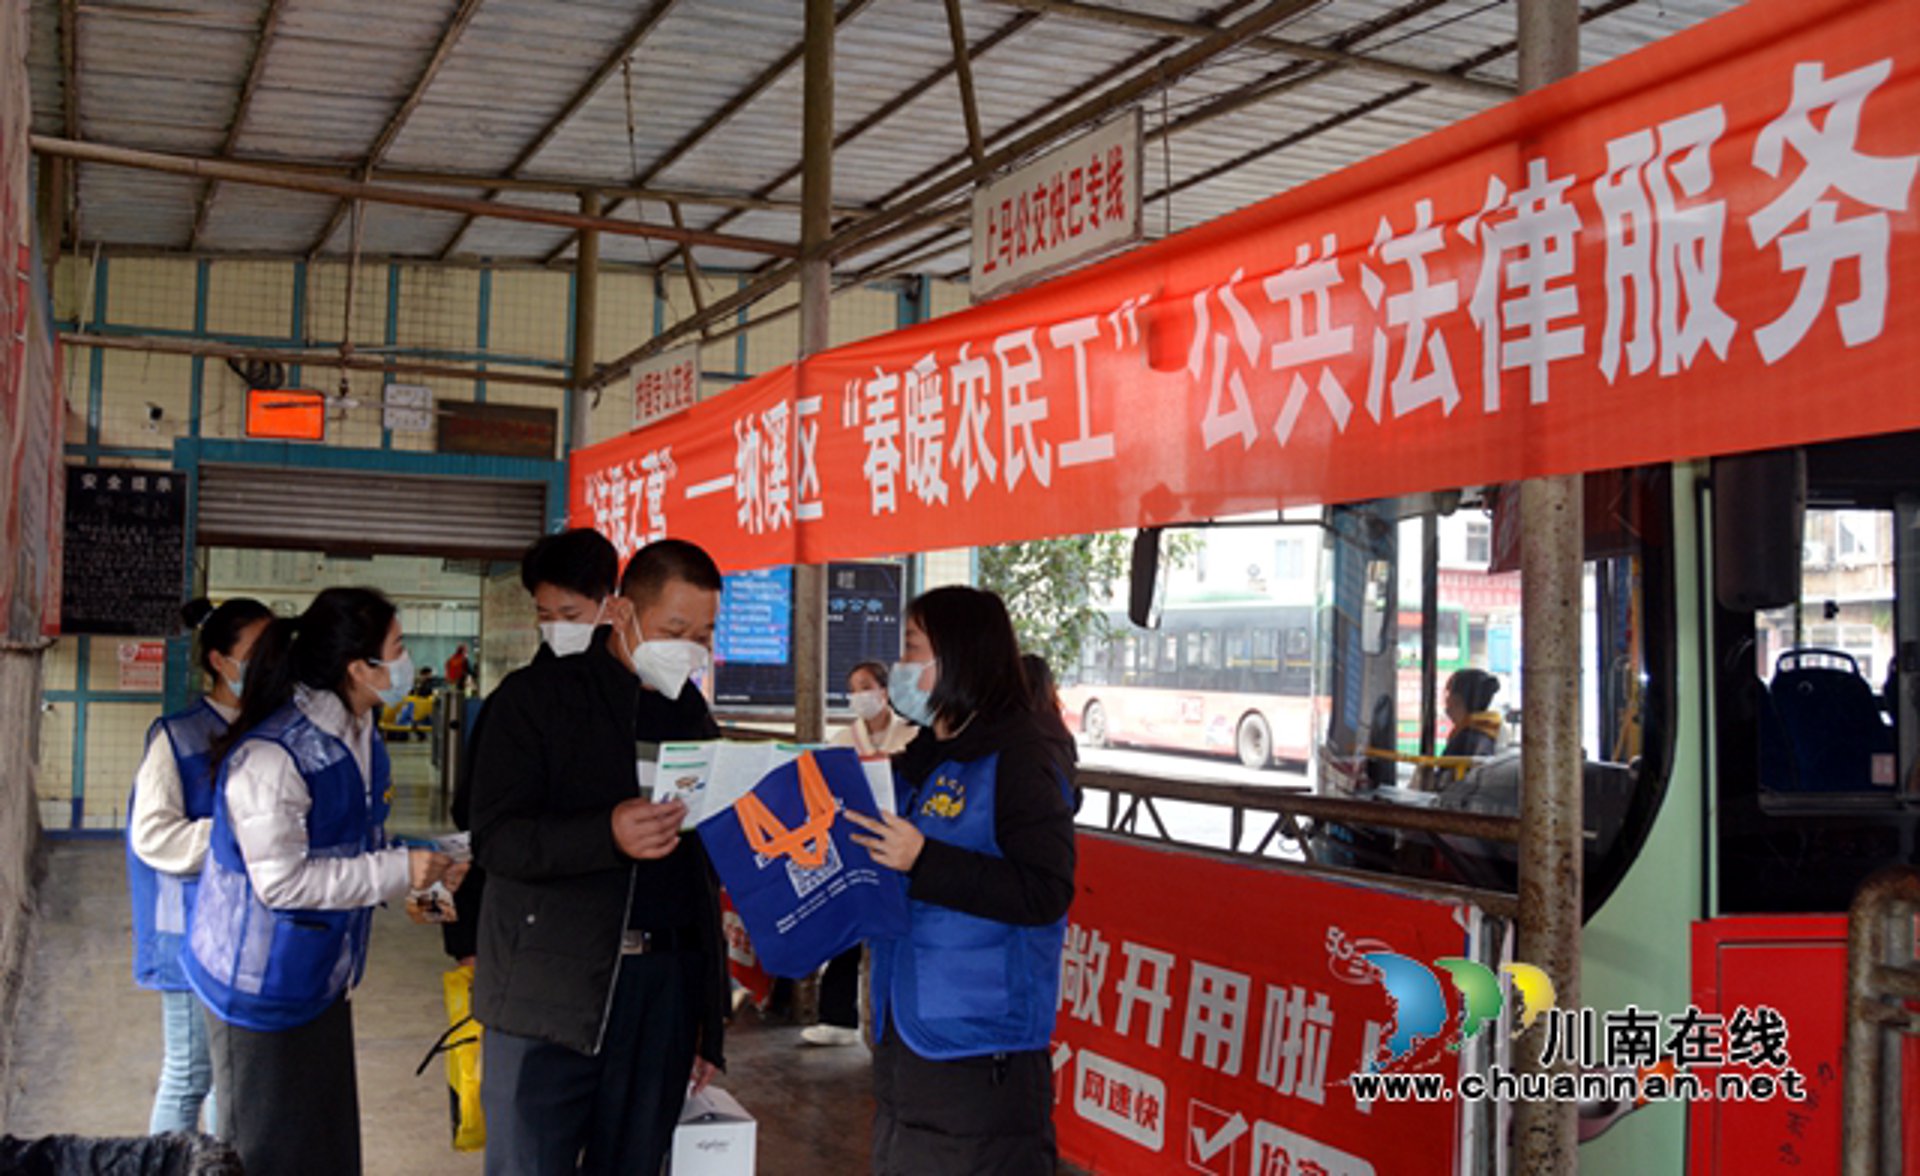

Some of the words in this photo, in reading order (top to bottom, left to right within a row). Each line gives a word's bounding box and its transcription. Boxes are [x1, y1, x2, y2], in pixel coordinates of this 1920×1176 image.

[983, 144, 1124, 275] 上马公交快巴专线
[81, 472, 172, 493] 安全提示
[1081, 1069, 1160, 1134] 网速快
